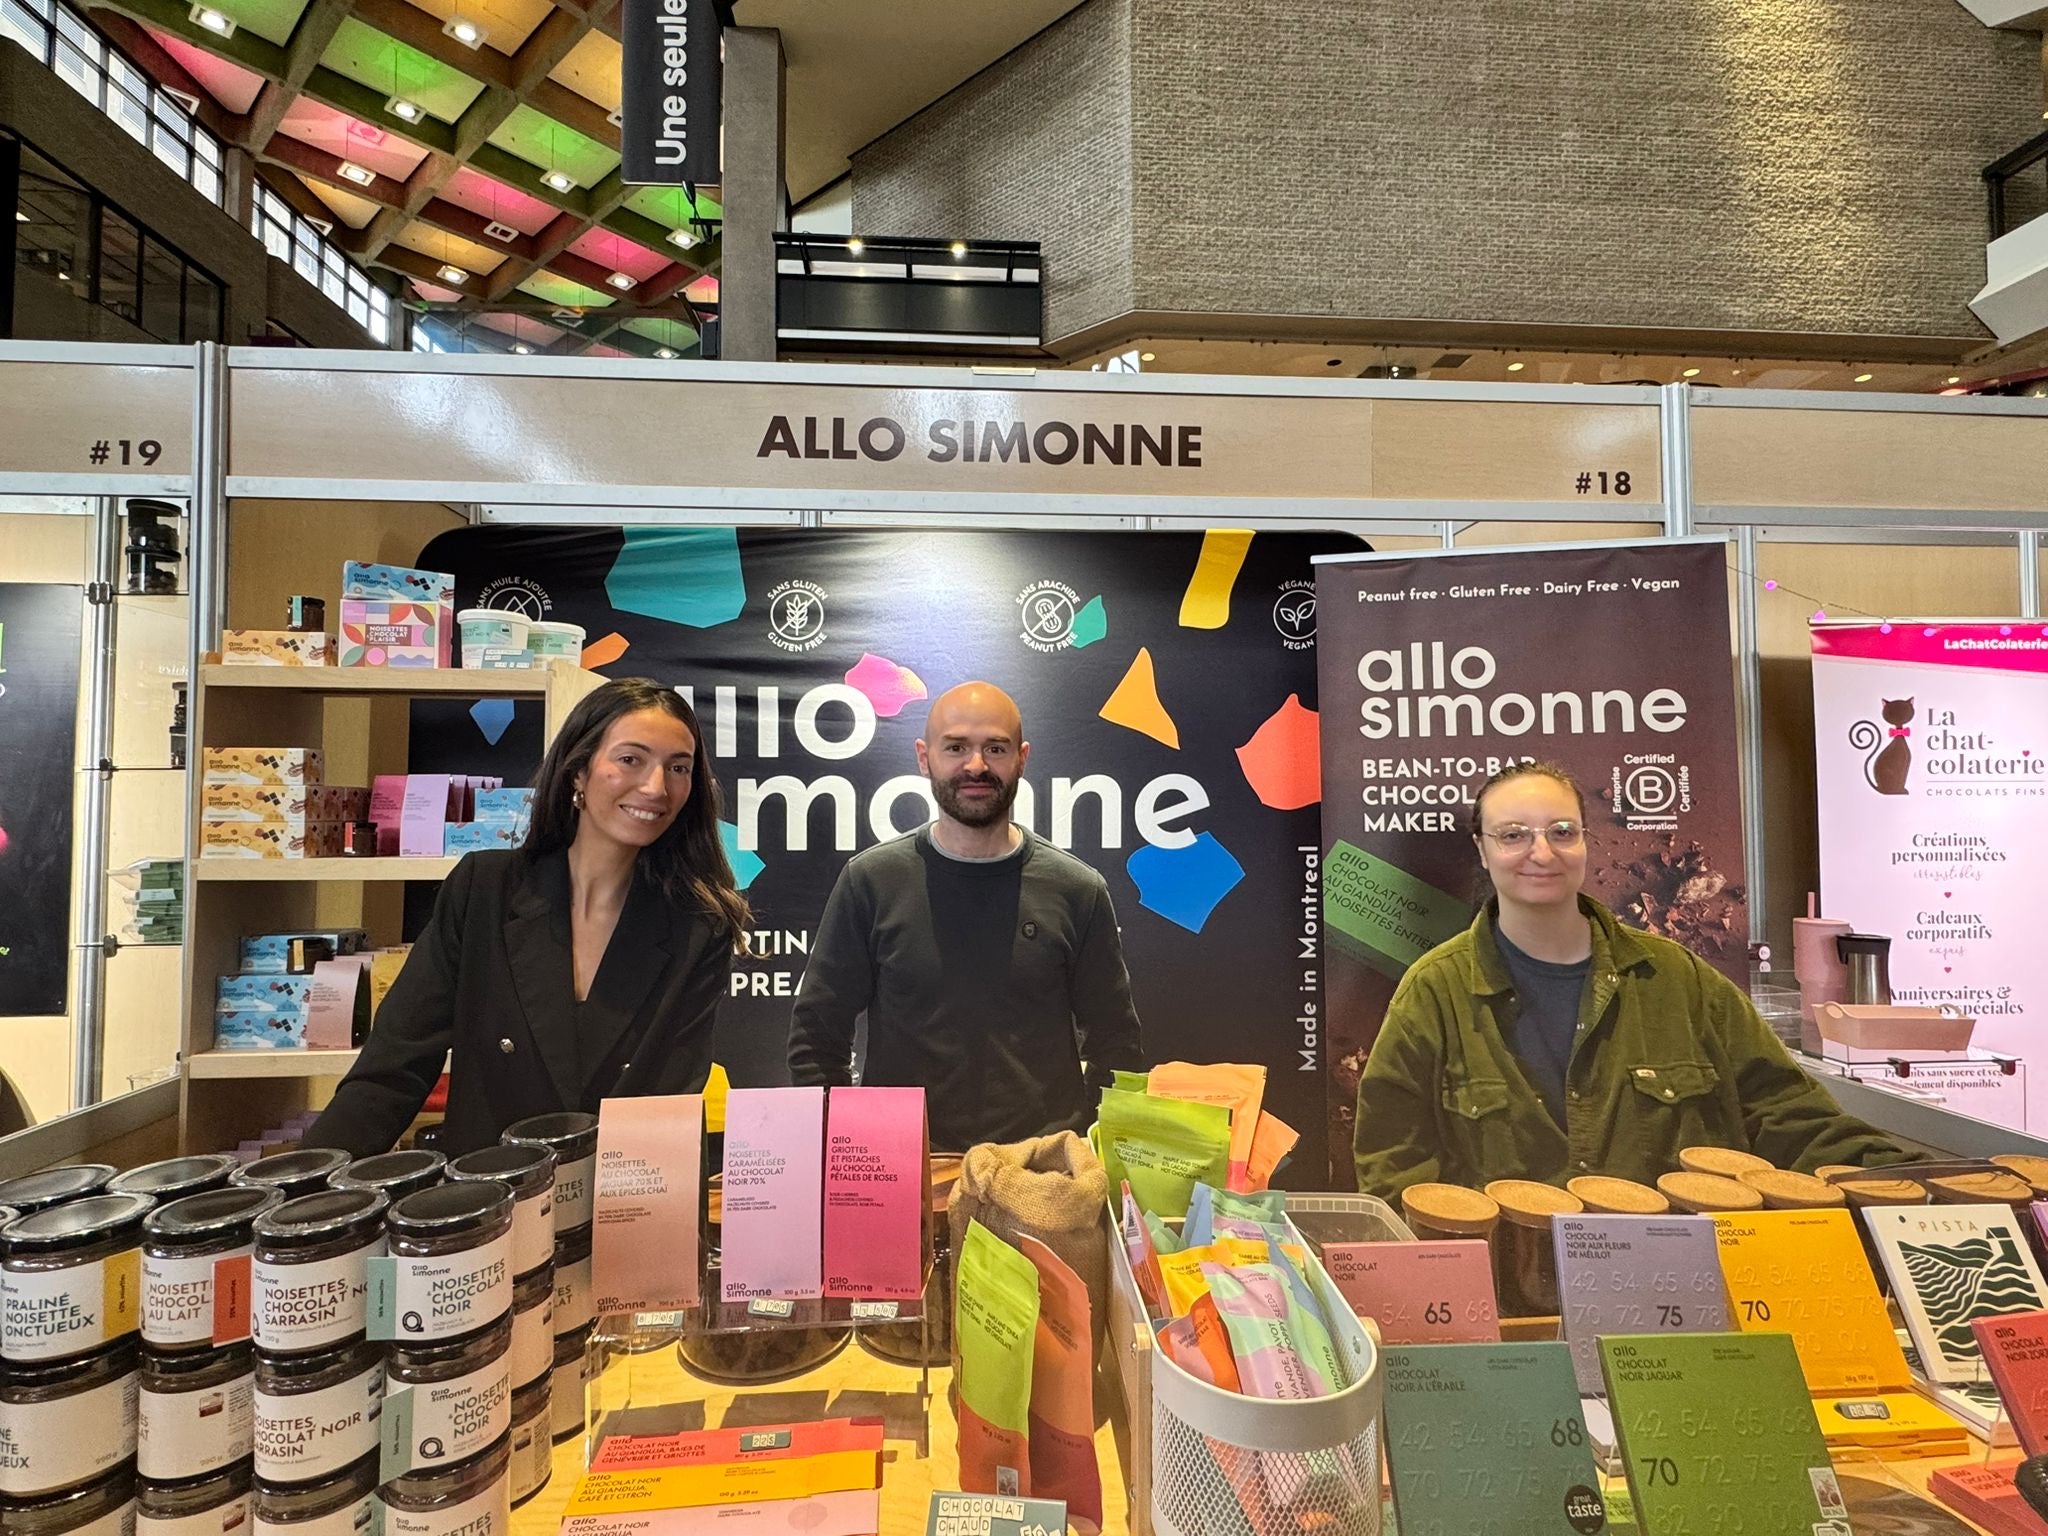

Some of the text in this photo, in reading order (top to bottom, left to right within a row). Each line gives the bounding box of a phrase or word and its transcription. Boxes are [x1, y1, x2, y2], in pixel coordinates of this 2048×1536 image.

[655, 0, 688, 165] Une seule
[757, 415, 1202, 468] ALLO SIMONNE
[89, 440, 162, 466] #19
[1575, 471, 1632, 496] #18
[476, 576, 553, 611] SANS HUILE AJOUTÉE
[767, 579, 829, 601] SANS GLUTEN
[1015, 579, 1081, 606] SANS ARACHIDE
[1358, 578, 1681, 603] Peanut free Gluten Free Dairy Free Vegan
[767, 631, 828, 652] GLUTEN FREE
[1019, 631, 1078, 653] PEANUT FREE
[1282, 638, 1315, 650] VEGAN
[1357, 641, 1497, 692] allo
[674, 682, 876, 760] llo
[1359, 688, 1688, 740] simonne
[1928, 708, 1956, 727] La
[1926, 729, 1994, 751] chat-
[1623, 753, 1675, 765] Certified
[1926, 752, 2046, 775] colaterie
[1362, 785, 1477, 806] CHOCOL
[1611, 766, 1622, 813] Entreprise
[1638, 775, 1664, 804] B
[1678, 765, 1691, 812] Certifiée
[1926, 788, 2046, 797] CHOCOLATS FINS
[1363, 812, 1456, 833] MAKER
[1626, 822, 1678, 831] Corporation
[1912, 832, 1987, 848] Créations
[1339, 850, 1371, 872] allo
[1892, 848, 2007, 866] personnalisées
[1331, 862, 1431, 917] CHOCOLAT NOIR
[1342, 880, 1404, 920] GIANDUJA
[1330, 891, 1394, 930] NOISETTES
[1916, 910, 1983, 925] Cadeaux
[1906, 926, 1993, 943] corporatifs
[1297, 846, 1318, 1071] Made in Montreal
[1947, 1079, 2002, 1090] disponibles
[832, 1136, 851, 1144] allo
[601, 1151, 623, 1160] allo
[728, 1150, 771, 1158] NOISETTES
[831, 1146, 868, 1154] GRIOTTES
[601, 1160, 647, 1169] NOISETTES
[728, 1156, 786, 1167] CARAMÉLISÉES
[841, 1155, 880, 1163] PISTACHES
[614, 1168, 660, 1178] CHOCOLAT
[741, 1167, 785, 1176] CHOCOLAT
[830, 1171, 898, 1182] PÉTALES ROSES
[727, 1178, 748, 1186] NOIR
[600, 1190, 618, 1198] AUX
[646, 1184, 668, 1194] CHAÏ
[1564, 1222, 1583, 1230] allo
[1717, 1228, 1756, 1237] CHOCOLAT
[1918, 1220, 1979, 1232] PISTA
[1565, 1232, 1607, 1241] CHOCOLAT
[1720, 1238, 1740, 1246] NOIR
[1566, 1242, 1586, 1250] NOIR
[1333, 1252, 1353, 1261] allo
[1579, 1250, 1611, 1259] MÉLILOT
[412, 1267, 451, 1277] simonne
[1334, 1262, 1377, 1272] CHOCOLAT
[432, 1258, 506, 1292] NOISETTES
[829, 1275, 848, 1285] allo
[1335, 1272, 1356, 1281] NOIR
[150, 1280, 213, 1296] NOISETT
[265, 1278, 349, 1300] NOISETTES,
[432, 1271, 506, 1305] CHOCOLAT
[726, 1282, 746, 1291] allo
[726, 1288, 772, 1298] simonne
[829, 1283, 873, 1292] simonne
[6, 1292, 71, 1311] PRALINÉ
[150, 1295, 212, 1308] CHOCOL
[264, 1290, 348, 1313] CHOCOLAT
[432, 1299, 472, 1318] NOIR
[597, 1297, 619, 1306] allo
[597, 1301, 647, 1312] simonne
[6, 1305, 81, 1324] NOISETTE
[149, 1307, 202, 1321] AU LAIT
[264, 1307, 337, 1327] SARRASIN
[1424, 1301, 1452, 1324] 65
[1657, 1305, 1683, 1327] 75
[1740, 1300, 1771, 1322] 70
[6, 1314, 96, 1337] ONCTUEUX
[1995, 1327, 2016, 1338] allo
[1268, 1321, 1287, 1354] PAVOT
[2000, 1336, 2045, 1351] CHOCOLAT
[1613, 1346, 1637, 1357] allo
[1386, 1356, 1410, 1367] allo
[1616, 1358, 1667, 1370] CHOCOLAT
[1388, 1369, 1440, 1380] CHOCOLAT
[1619, 1370, 1683, 1382] NOIR JAGUAR
[1390, 1379, 1466, 1392] NOIR L'ÉRABLE
[321, 1411, 361, 1438] NOIR
[453, 1415, 490, 1440] NOIR
[1550, 1417, 1583, 1447] 68
[607, 1442, 656, 1450] CHOCOLAT
[663, 1451, 706, 1460] GRIOTTES
[588, 1474, 611, 1482] allo
[1640, 1457, 1679, 1487] 70
[584, 1476, 661, 1488] CHOCOLAT NOIR
[616, 1491, 652, 1500] CITRON
[1573, 1495, 1592, 1506] great
[941, 1500, 1024, 1516] CHOCOLAT
[1567, 1503, 1603, 1517] taste
[567, 1521, 651, 1533] CHOCOLAT NOIR
[571, 1517, 597, 1526] allo
[938, 1518, 990, 1533] CHAUD
